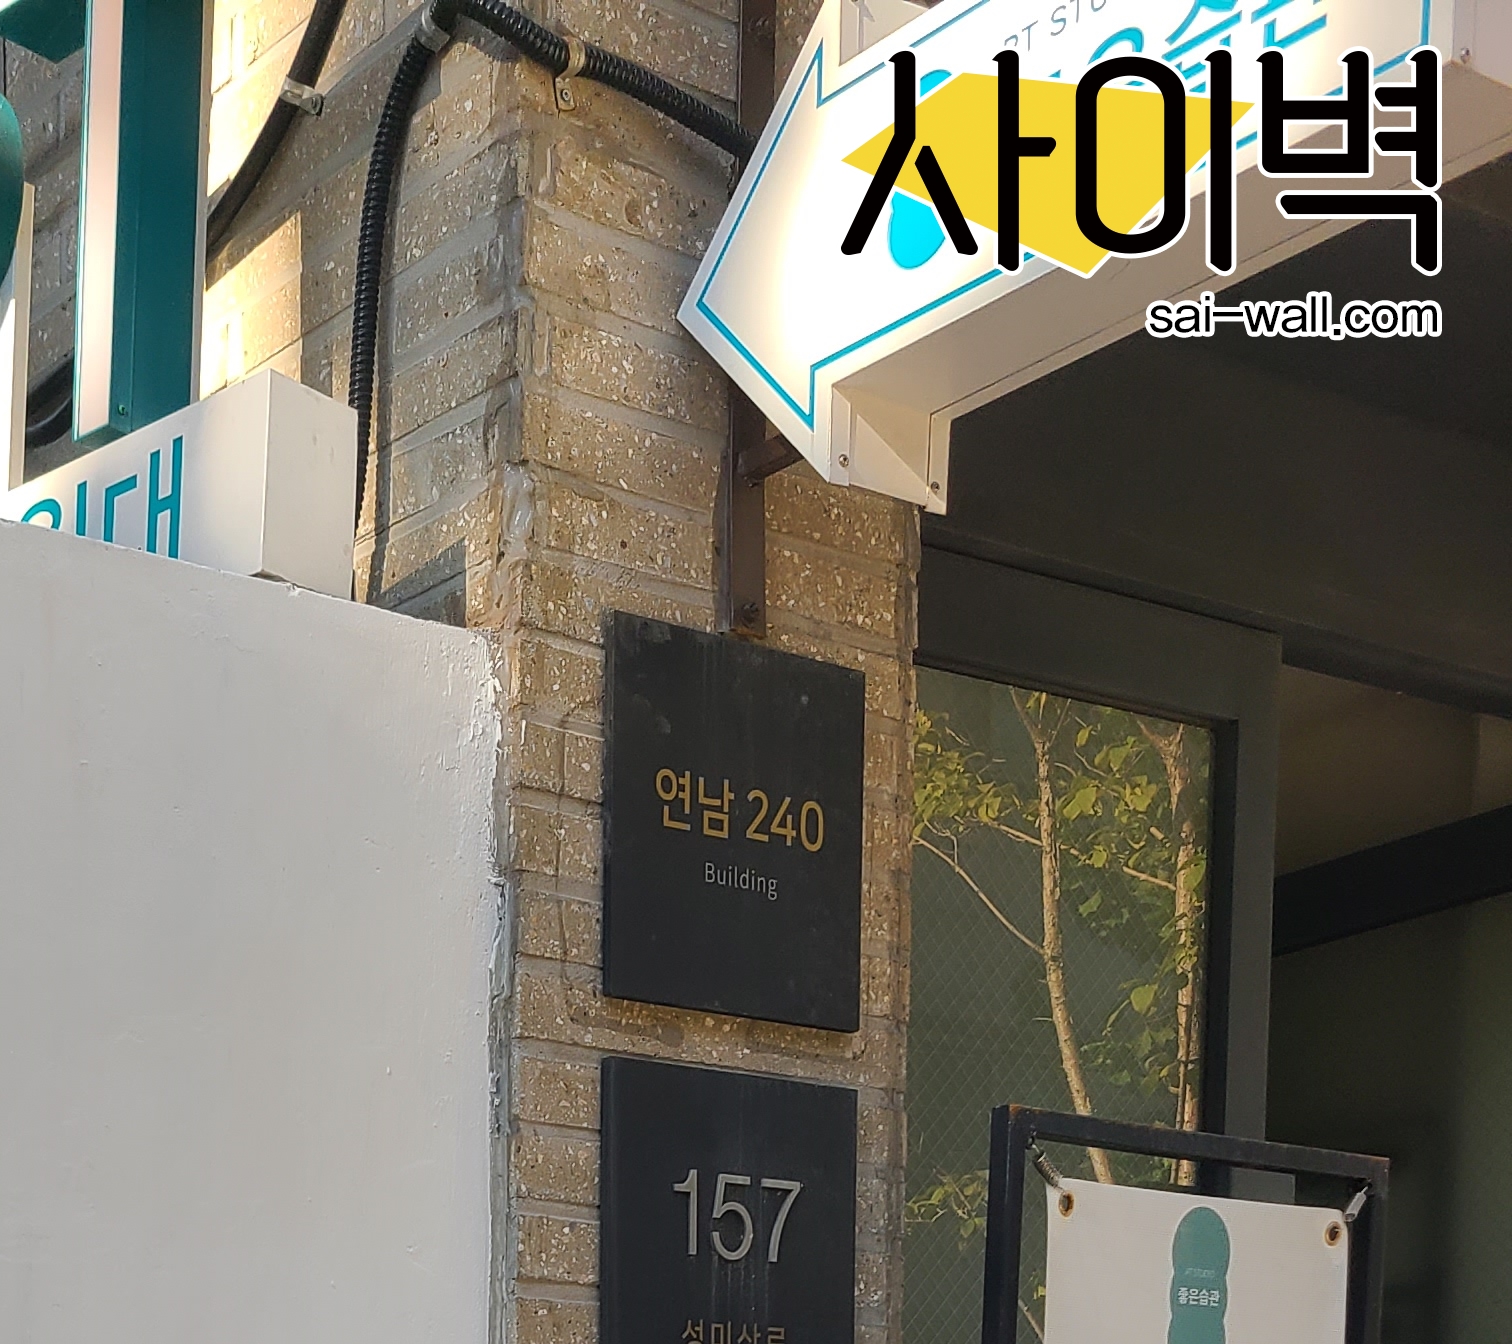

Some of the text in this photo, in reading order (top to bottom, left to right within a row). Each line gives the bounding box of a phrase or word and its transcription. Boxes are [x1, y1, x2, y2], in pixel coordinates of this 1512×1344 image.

[655, 768, 825, 852] 연남 240
[704, 862, 778, 900] Building
[672, 1168, 801, 1263] 157
[1177, 1286, 1220, 1307] 좋은습관
